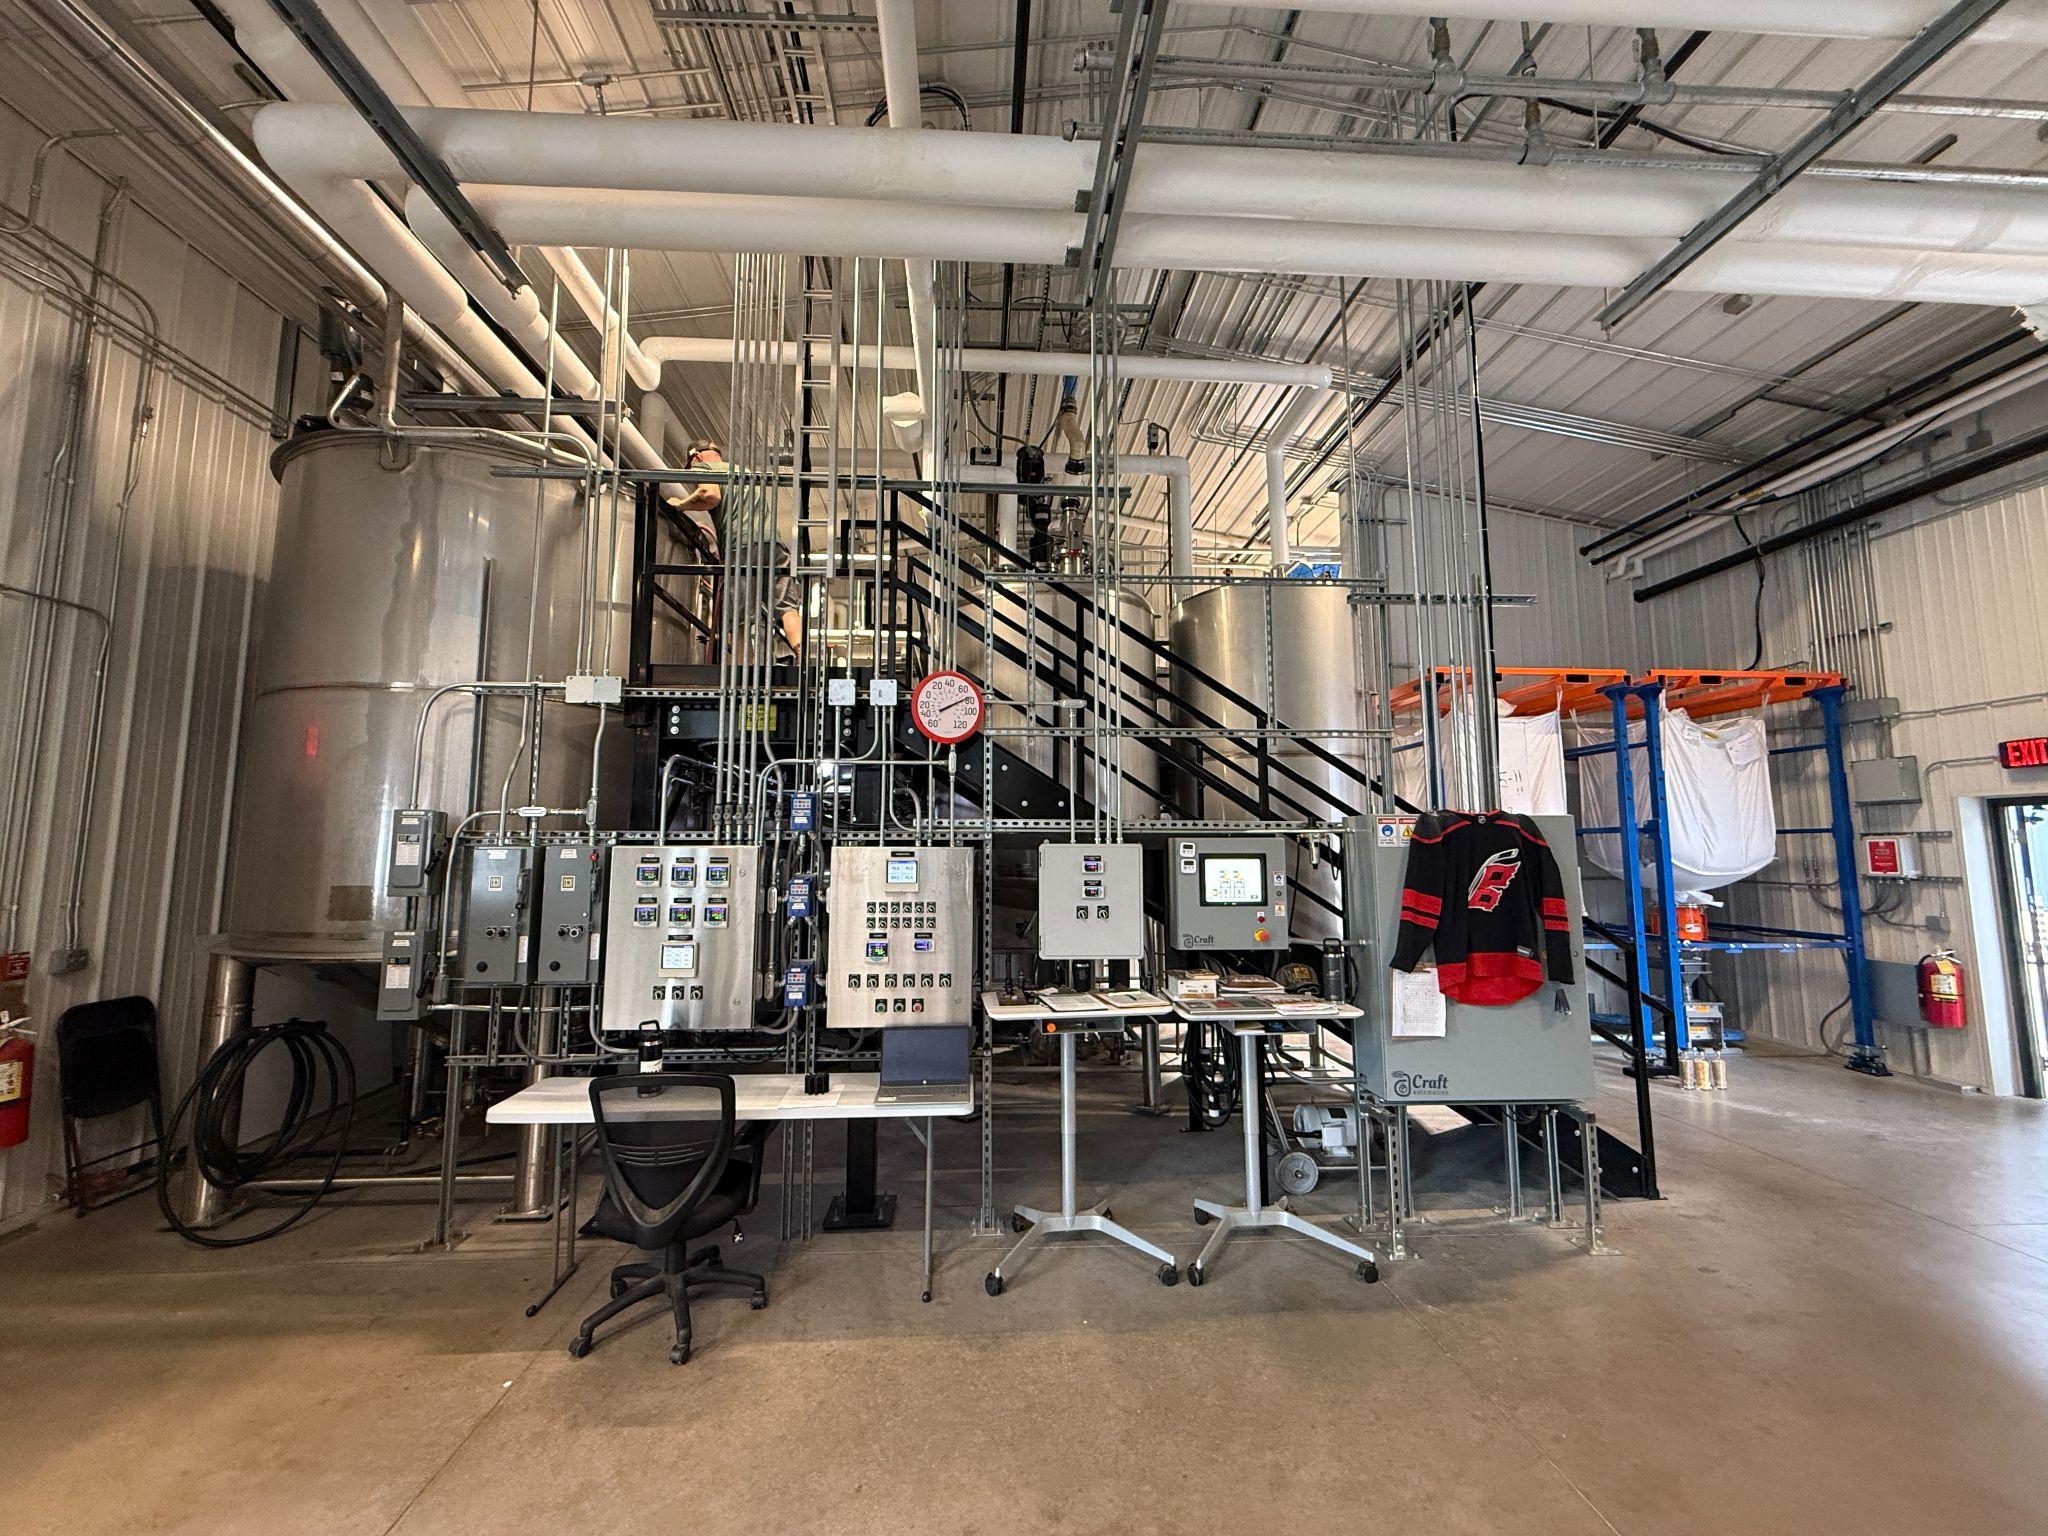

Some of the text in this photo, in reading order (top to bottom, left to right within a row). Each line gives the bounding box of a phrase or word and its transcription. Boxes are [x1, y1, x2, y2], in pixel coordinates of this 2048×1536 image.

[932, 682, 943, 690] 20
[945, 679, 954, 688] 40
[958, 685, 969, 694] 60
[926, 691, 931, 699] 0
[964, 707, 978, 716] 100
[953, 720, 968, 729] 120
[2006, 739, 2048, 767] EXIT
[1194, 934, 1214, 943] Craft
[1413, 1074, 1449, 1089] Craft
